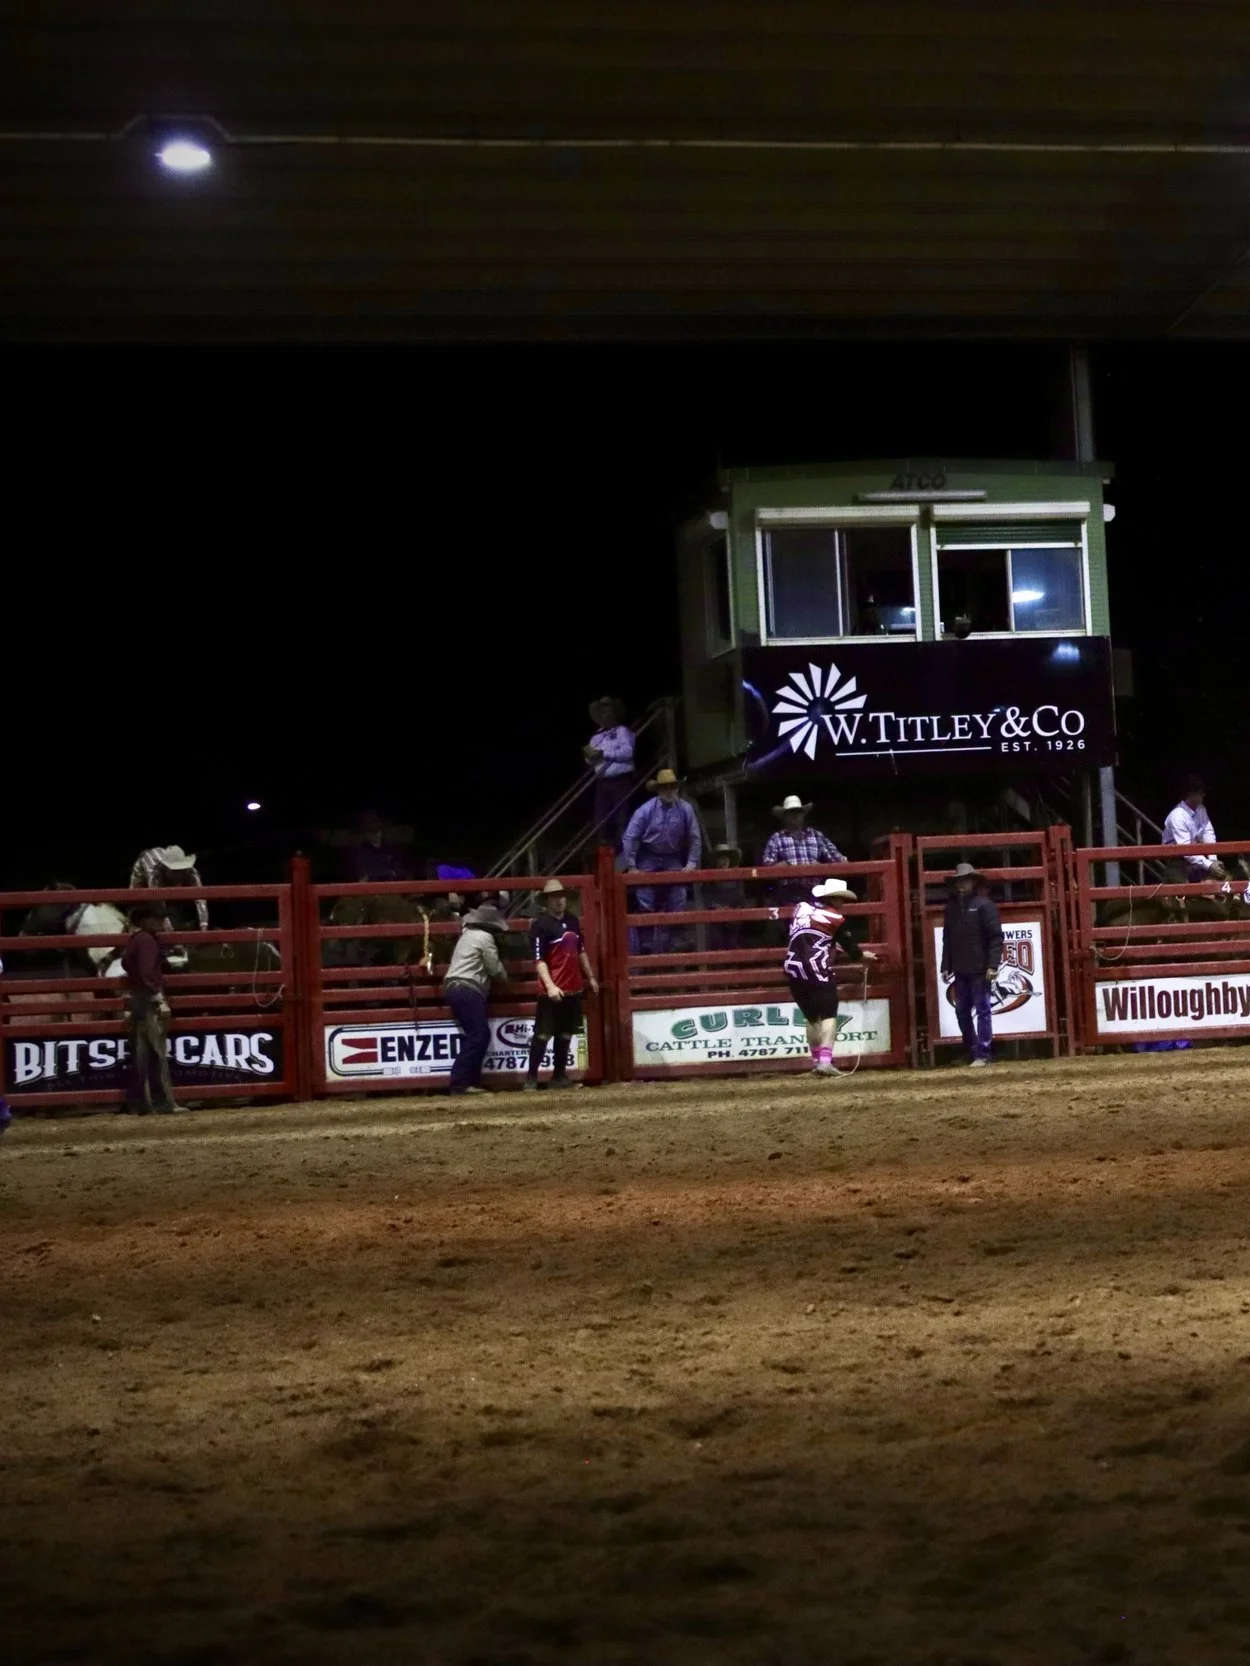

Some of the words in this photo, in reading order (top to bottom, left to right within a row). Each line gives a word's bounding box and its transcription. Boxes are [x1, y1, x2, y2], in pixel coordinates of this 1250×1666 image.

[1001, 741, 1038, 753] EST.
[1047, 739, 1086, 751] 1926
[768, 907, 779, 920] 3
[380, 1033, 464, 1063] ENZED
[646, 1038, 733, 1052] CATTLE
[741, 1030, 877, 1048] TRANORT
[738, 1047, 777, 1057] 4787
[784, 1045, 809, 1056] 711
[484, 1055, 528, 1070] 4787
